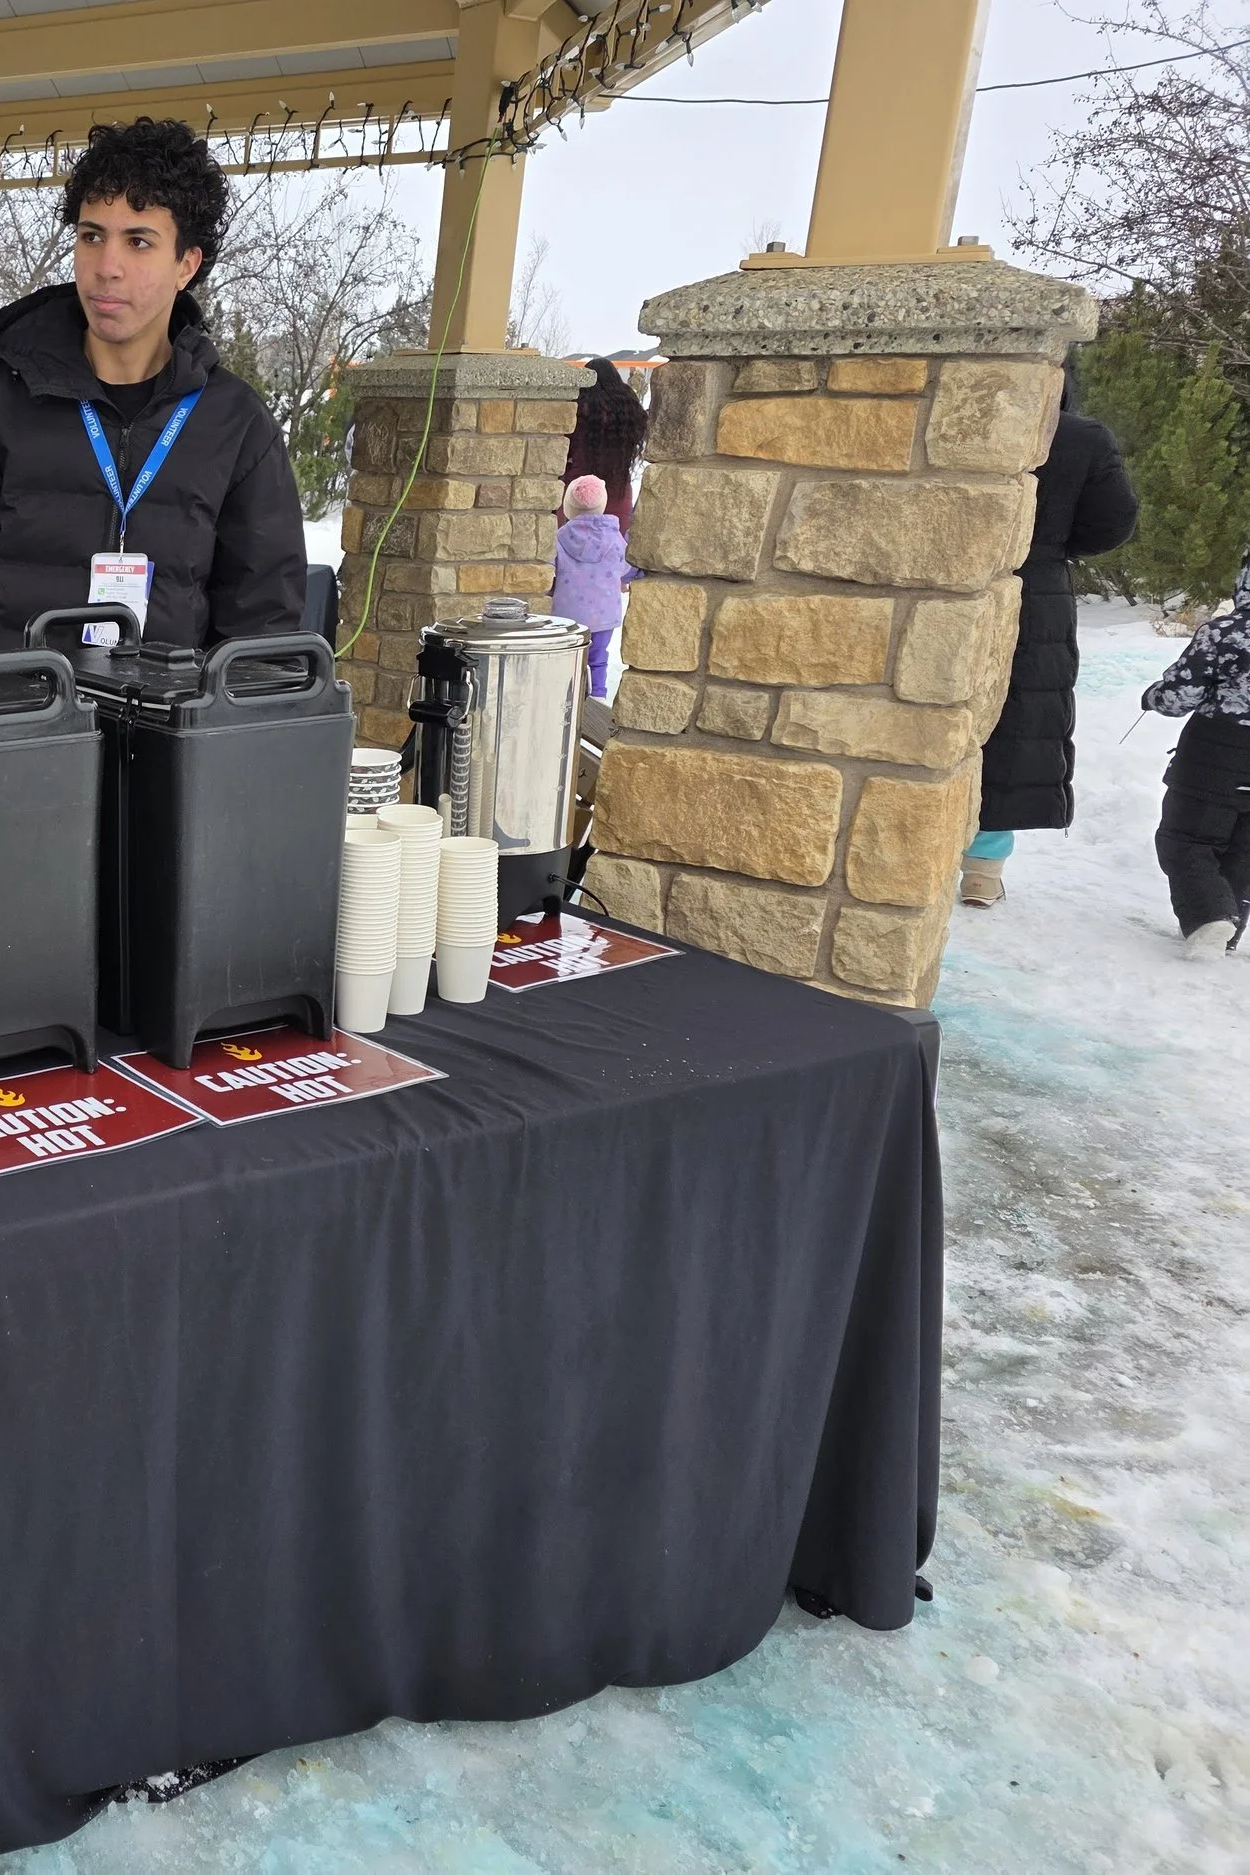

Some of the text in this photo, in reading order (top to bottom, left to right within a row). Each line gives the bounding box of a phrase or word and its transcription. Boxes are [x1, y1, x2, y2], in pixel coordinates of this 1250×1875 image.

[161, 407, 188, 447] VOLUNTEER
[105, 565, 135, 574] EMERGENCY
[194, 1051, 362, 1093] CAUTION:
[269, 1075, 354, 1103] HOT
[16, 1124, 106, 1157] HOT
